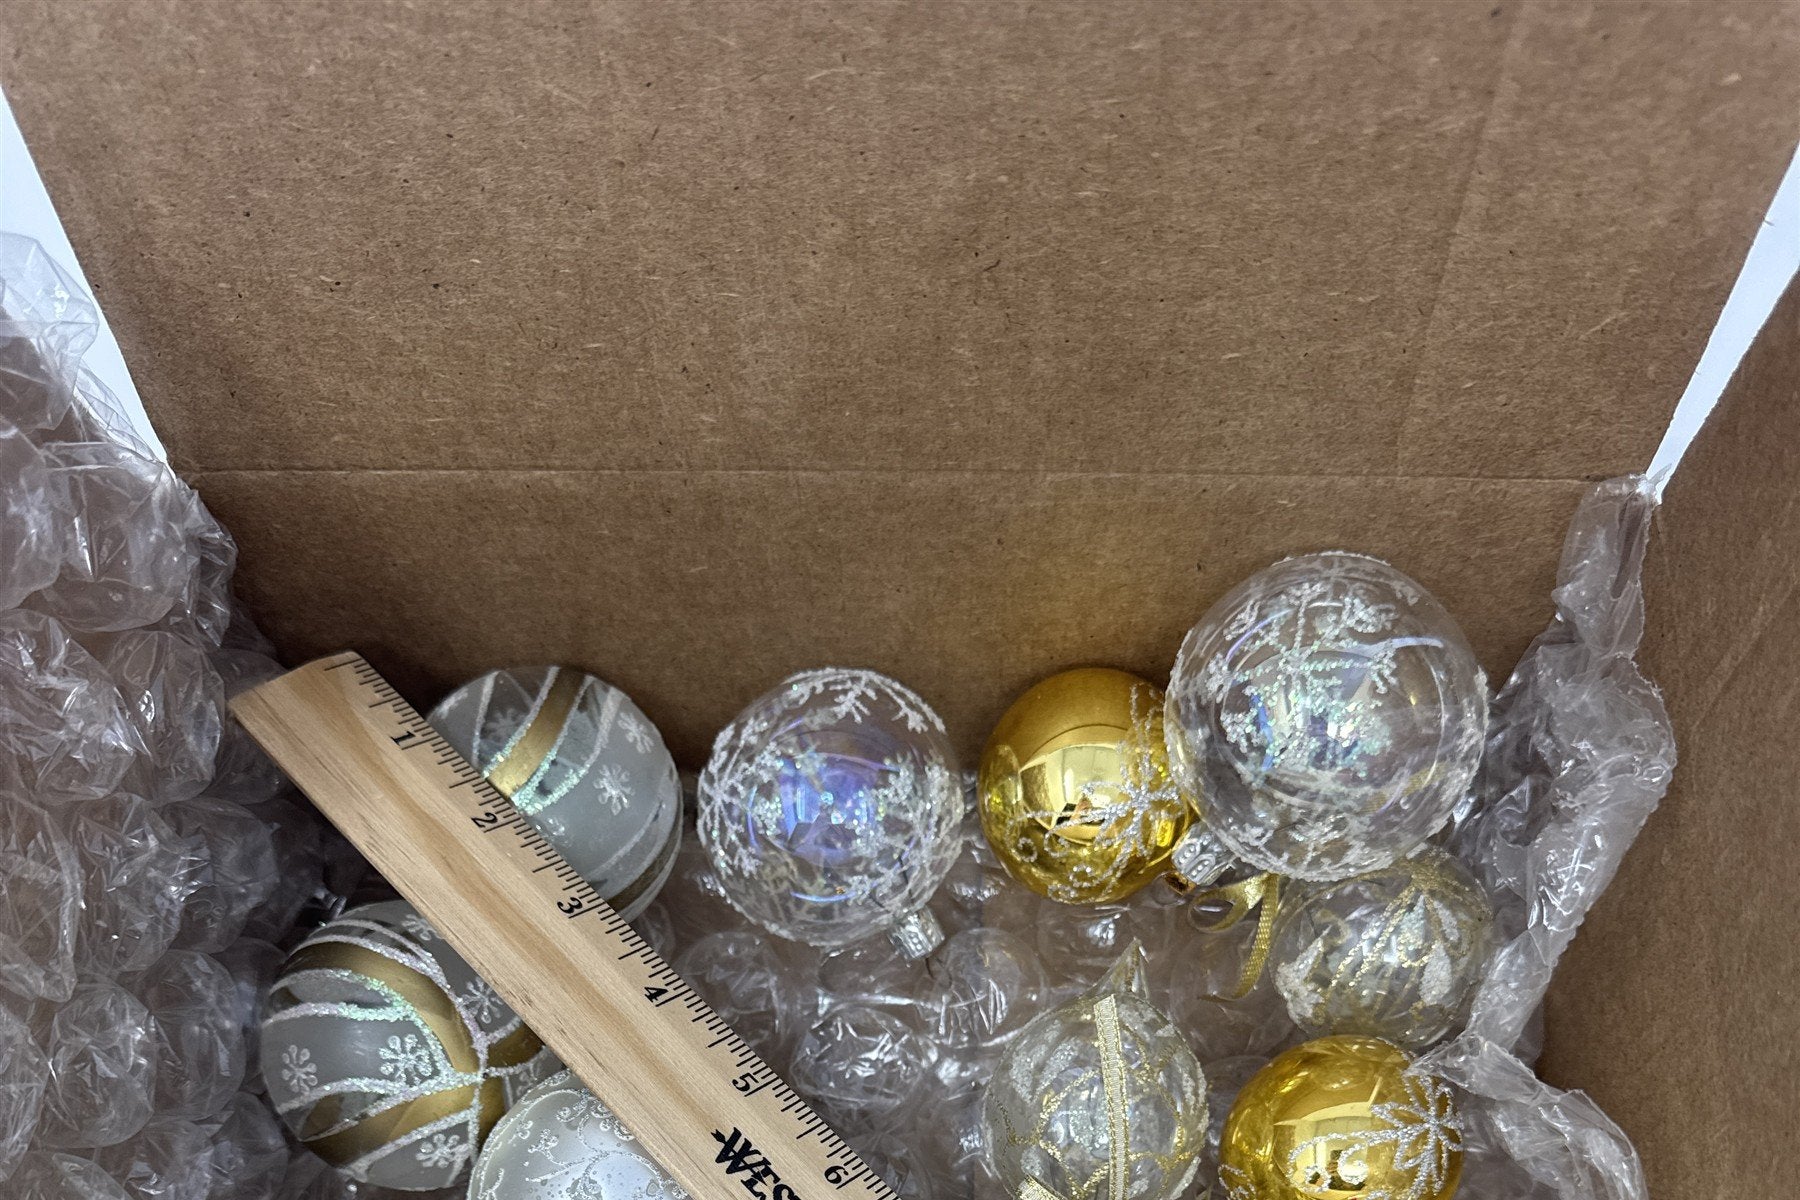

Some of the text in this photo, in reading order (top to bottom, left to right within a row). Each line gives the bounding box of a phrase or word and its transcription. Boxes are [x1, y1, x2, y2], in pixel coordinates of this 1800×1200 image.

[390, 730, 416, 746] 1
[471, 811, 499, 829] 2
[556, 896, 583, 917] 3
[644, 985, 669, 1004] 4
[731, 1072, 759, 1093] 5
[824, 1165, 850, 1185] 6
